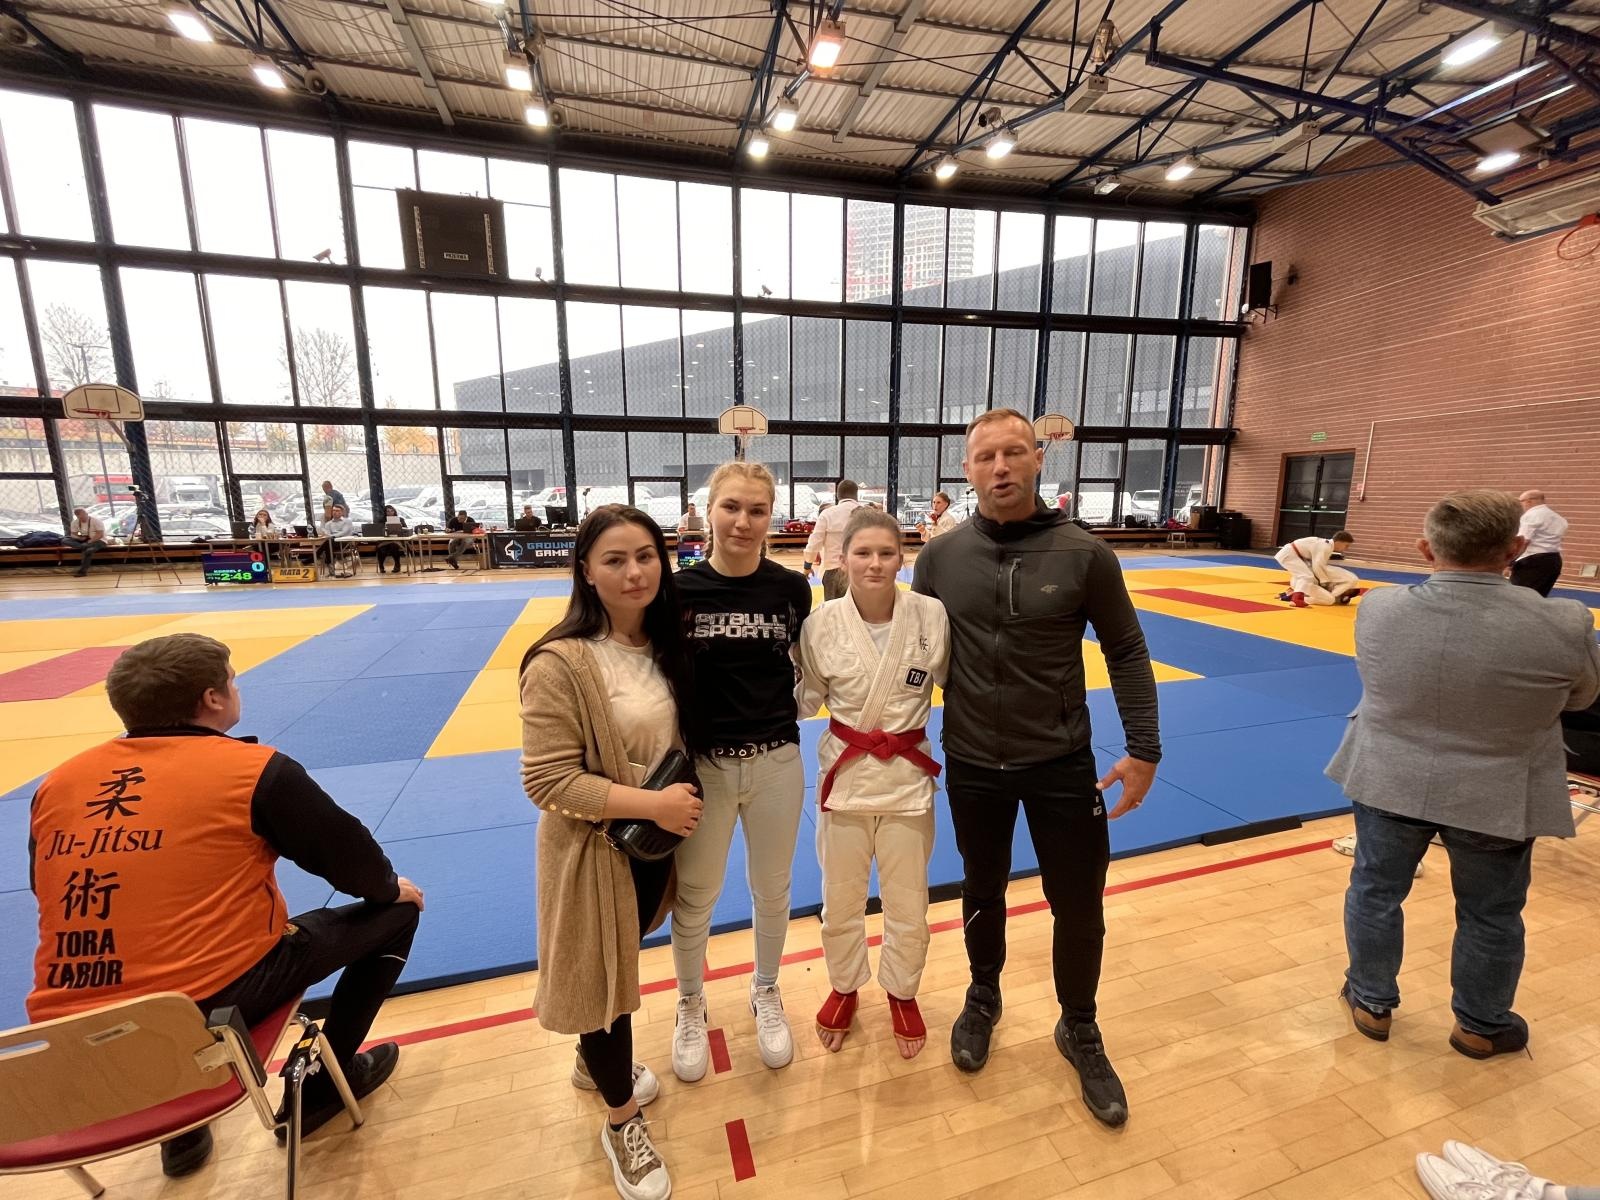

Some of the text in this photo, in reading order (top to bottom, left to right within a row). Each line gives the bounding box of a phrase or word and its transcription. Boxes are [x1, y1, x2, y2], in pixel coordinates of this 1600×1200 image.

[527, 541, 576, 550] GROUND
[250, 552, 263, 562] 0
[535, 549, 569, 557] GAME
[251, 562, 265, 572] 0
[279, 568, 310, 579] MATA 2
[220, 572, 253, 581] 2:48
[695, 612, 785, 626] PITBULL
[694, 624, 787, 639] SPORTS
[83, 766, 146, 821] 柔
[44, 825, 164, 861] Ju-Jitsu
[60, 867, 121, 921] 術
[55, 928, 116, 958] TORA
[47, 956, 124, 989] ZABÓR
